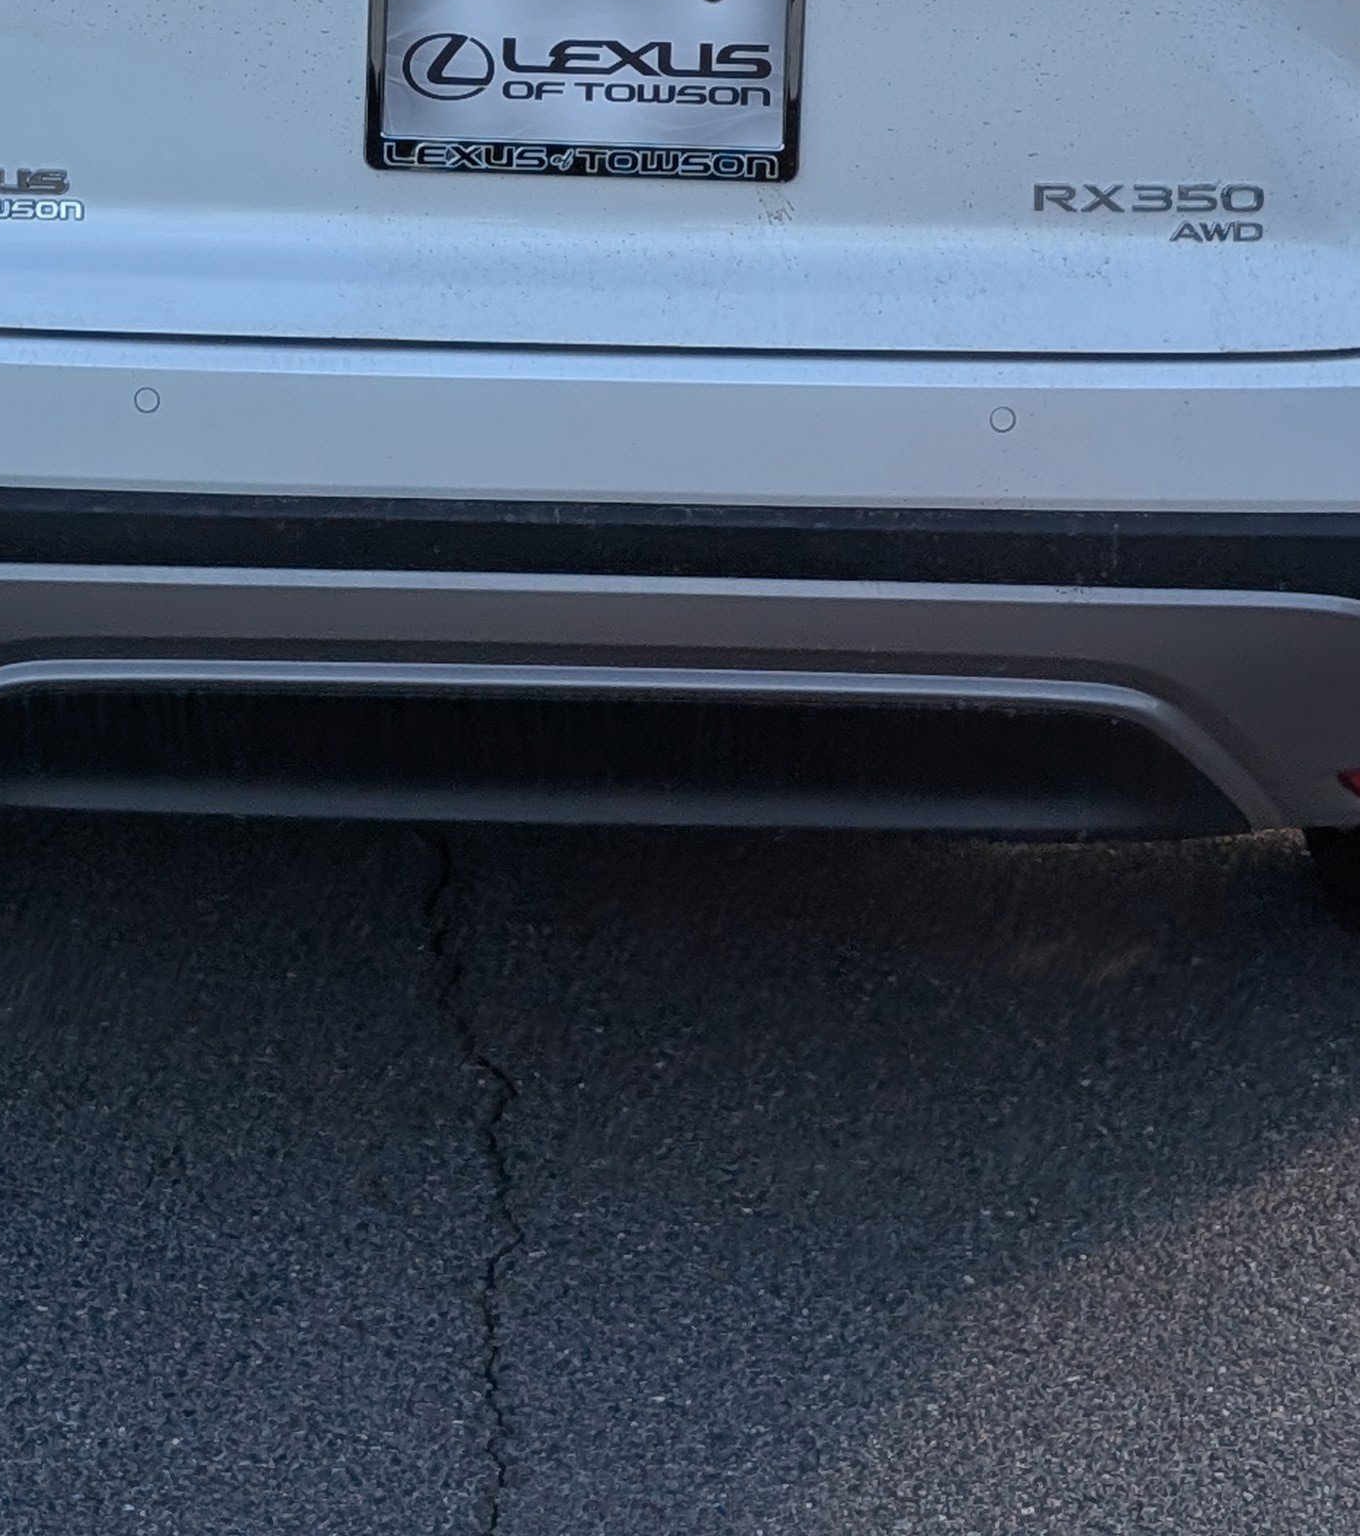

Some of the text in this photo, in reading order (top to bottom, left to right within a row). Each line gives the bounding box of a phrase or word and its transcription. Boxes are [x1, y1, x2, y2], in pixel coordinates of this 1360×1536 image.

[502, 37, 772, 79] LEXUS
[502, 80, 771, 107] OF TOWSON
[383, 142, 548, 170] LEXUS
[574, 149, 779, 179] TOWSON
[1169, 220, 1264, 243] AWD
